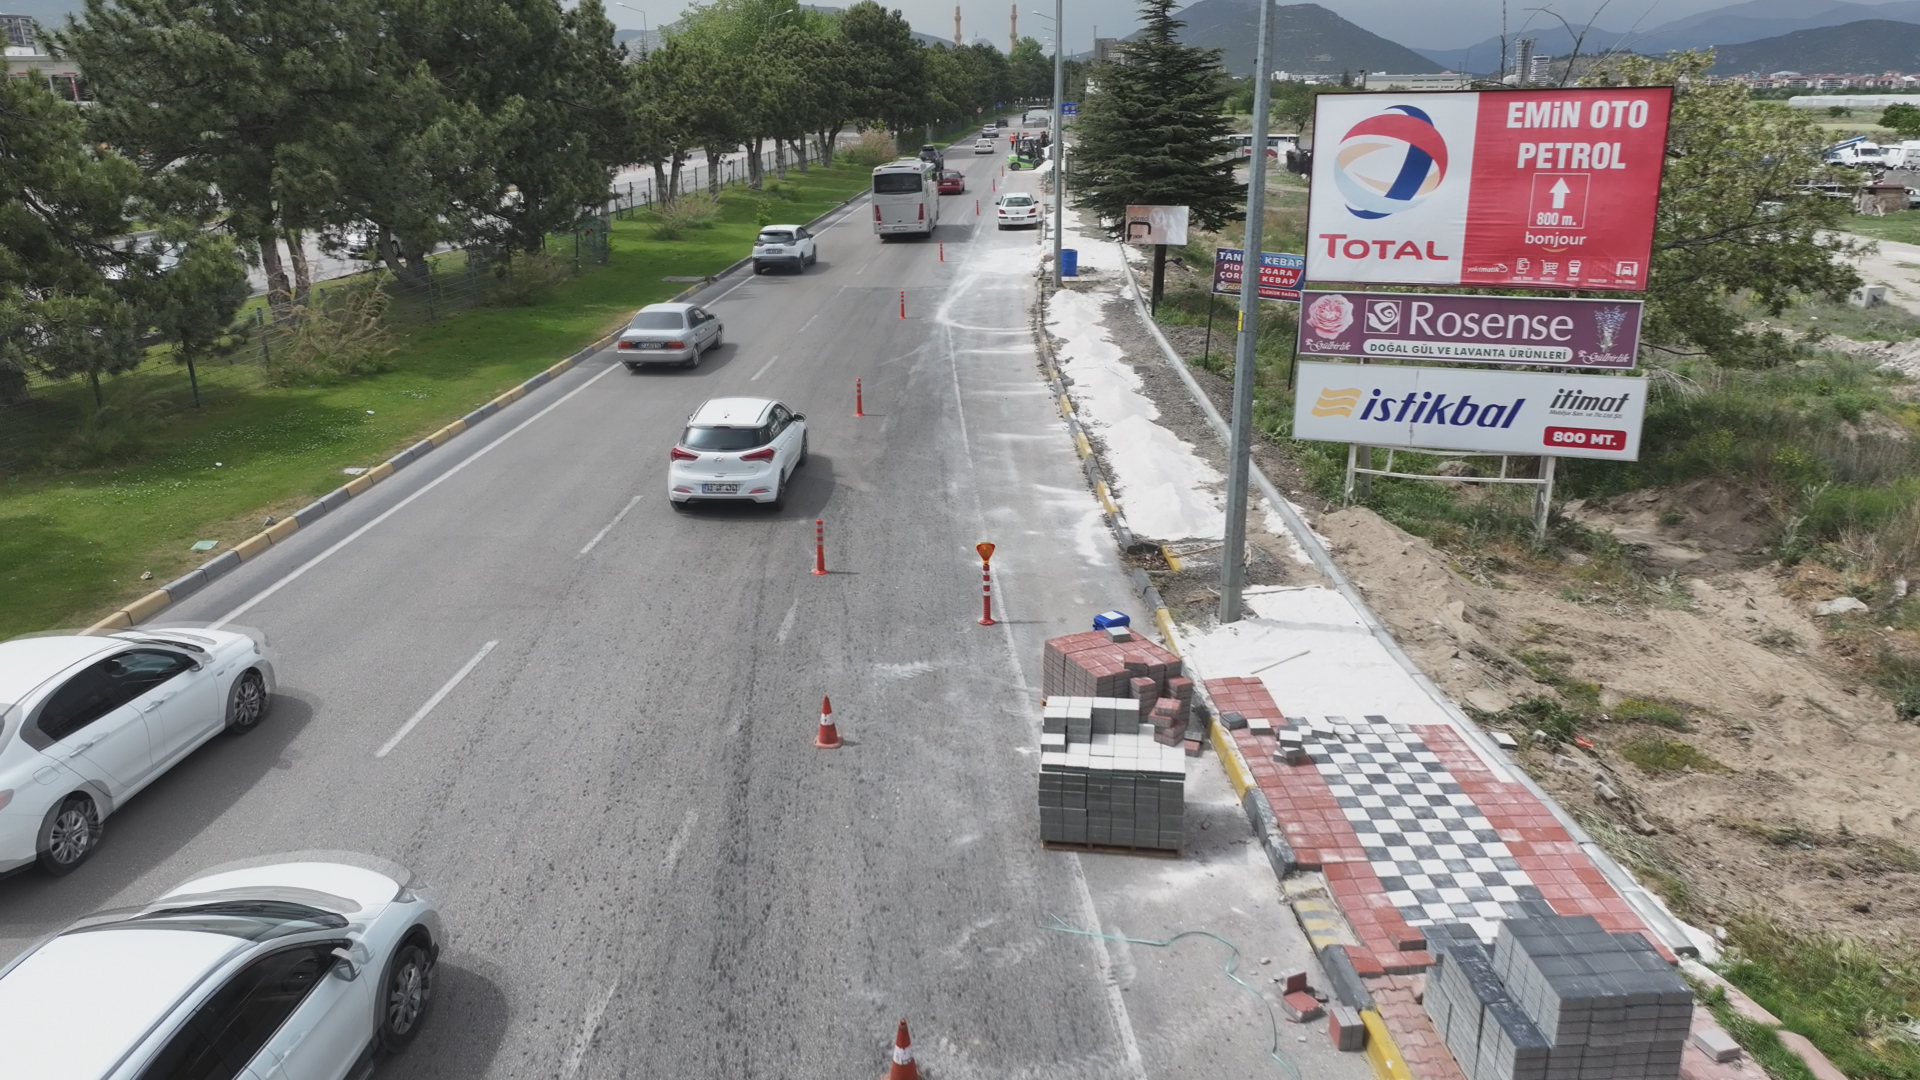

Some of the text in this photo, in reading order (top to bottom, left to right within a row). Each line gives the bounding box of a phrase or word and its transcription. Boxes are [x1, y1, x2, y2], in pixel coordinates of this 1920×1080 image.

[1589, 99, 1648, 129] OTO
[1516, 142, 1626, 170] PETROL
[1536, 212, 1577, 226] 800 m.
[1318, 233, 1449, 261] TOTAL
[1524, 231, 1587, 248] bonjour
[1264, 256, 1304, 267] KEBAP
[1259, 267, 1293, 277] ZGARA
[1261, 276, 1296, 285] KEBAP
[1409, 301, 1574, 342] Rosense
[1370, 342, 1567, 360] DOĞAL GÜL VE LAVANTA ÜRÜNLERİ
[1359, 387, 1526, 429] istikbal
[1549, 388, 1630, 412] itimat
[1552, 431, 1617, 446] 800 MT.
